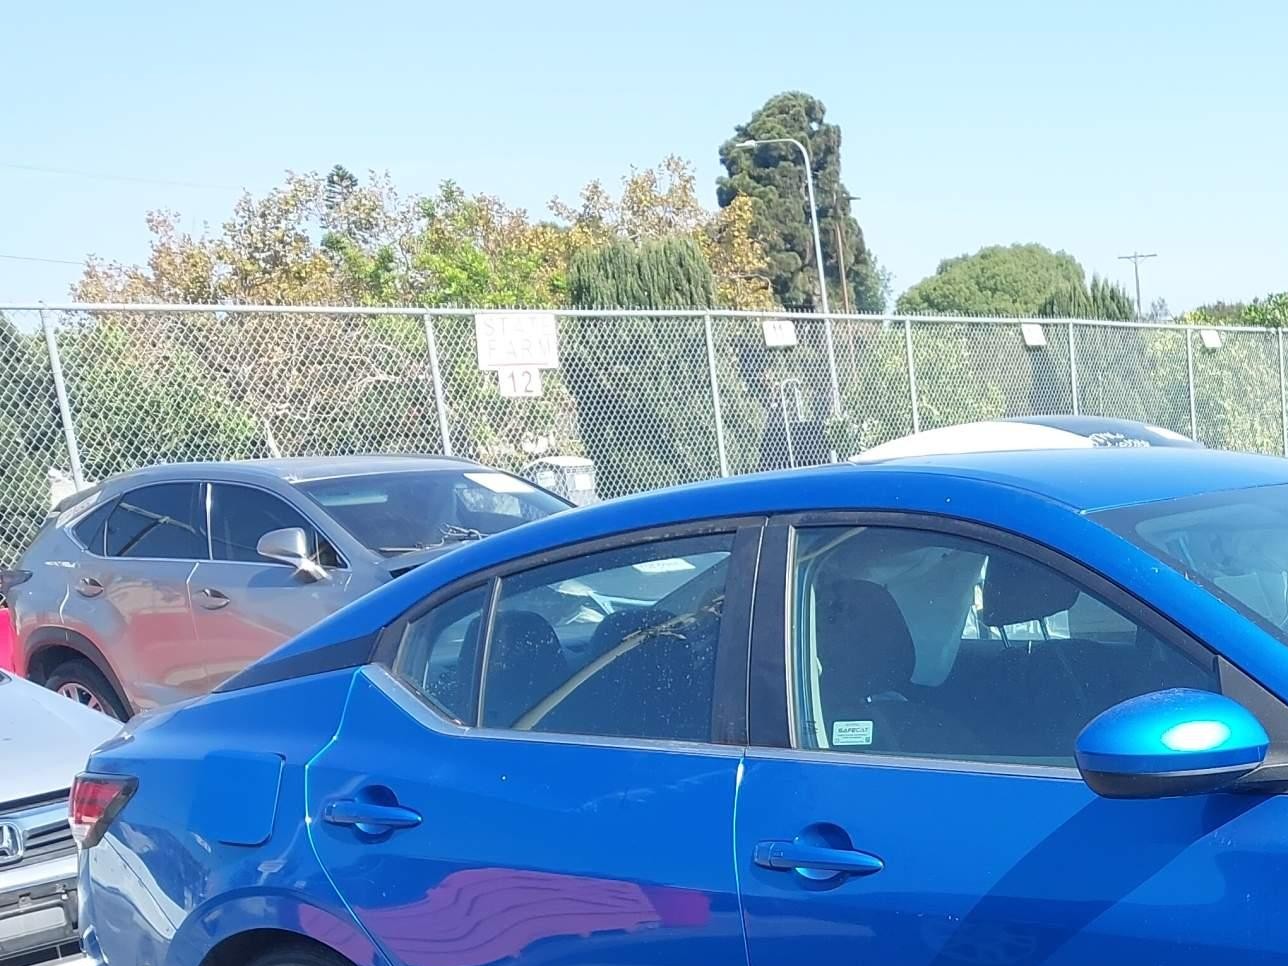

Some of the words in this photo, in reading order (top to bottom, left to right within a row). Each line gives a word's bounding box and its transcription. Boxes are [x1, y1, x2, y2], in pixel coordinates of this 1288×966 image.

[483, 316, 552, 337] STATE
[487, 338, 551, 360] FARM
[507, 370, 534, 393] 12
